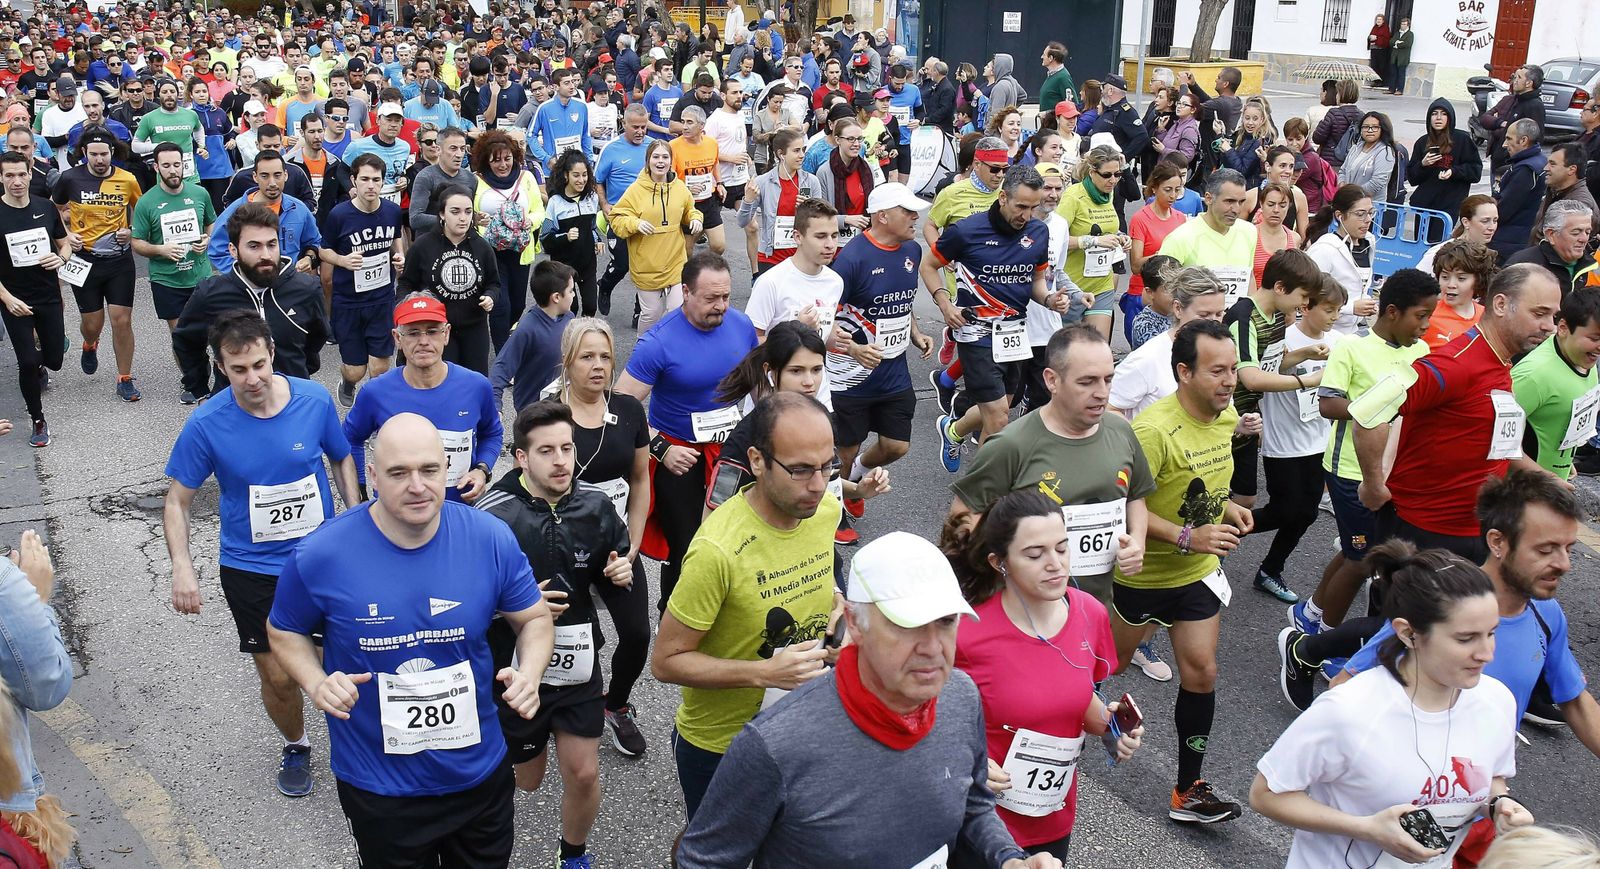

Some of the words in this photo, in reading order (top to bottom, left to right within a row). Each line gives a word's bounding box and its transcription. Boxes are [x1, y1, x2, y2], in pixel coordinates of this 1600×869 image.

[1459, 0, 1485, 14] BAR
[1443, 28, 1466, 50] ECHATE
[1469, 32, 1494, 51] PALLA
[81, 190, 124, 201] bichos
[168, 222, 194, 235] 1042
[349, 225, 395, 246] UCAM
[24, 244, 38, 255] 12
[1098, 254, 1108, 265] 61
[365, 267, 383, 280] 817
[982, 264, 1034, 274] CERRADO
[978, 272, 1032, 284] CALDERÓN
[436, 284, 450, 298] NEW
[883, 331, 907, 347] 1034
[1003, 335, 1021, 348] 953
[1576, 410, 1593, 431] 891
[1500, 421, 1517, 438] 439
[1188, 463, 1196, 471] VI
[1196, 459, 1212, 470] Media
[269, 504, 305, 525] 287
[1079, 531, 1114, 554] 667
[799, 561, 808, 569] de
[808, 557, 815, 565] la
[760, 590, 771, 600] VI
[773, 581, 800, 596] Media
[801, 565, 832, 585] Maratón
[785, 593, 803, 605] Carrera
[803, 584, 823, 596] Popular
[359, 633, 415, 646] CARRERA
[416, 627, 465, 640] URBANA
[360, 644, 399, 652] CIUDAD
[424, 635, 465, 644] MÁLAGA
[549, 652, 575, 669] 98
[407, 702, 456, 729] 280
[408, 738, 430, 747] CARRERA
[1027, 767, 1068, 791] 134
[1420, 775, 1449, 799] 40
[1013, 799, 1035, 807] CARRERA
